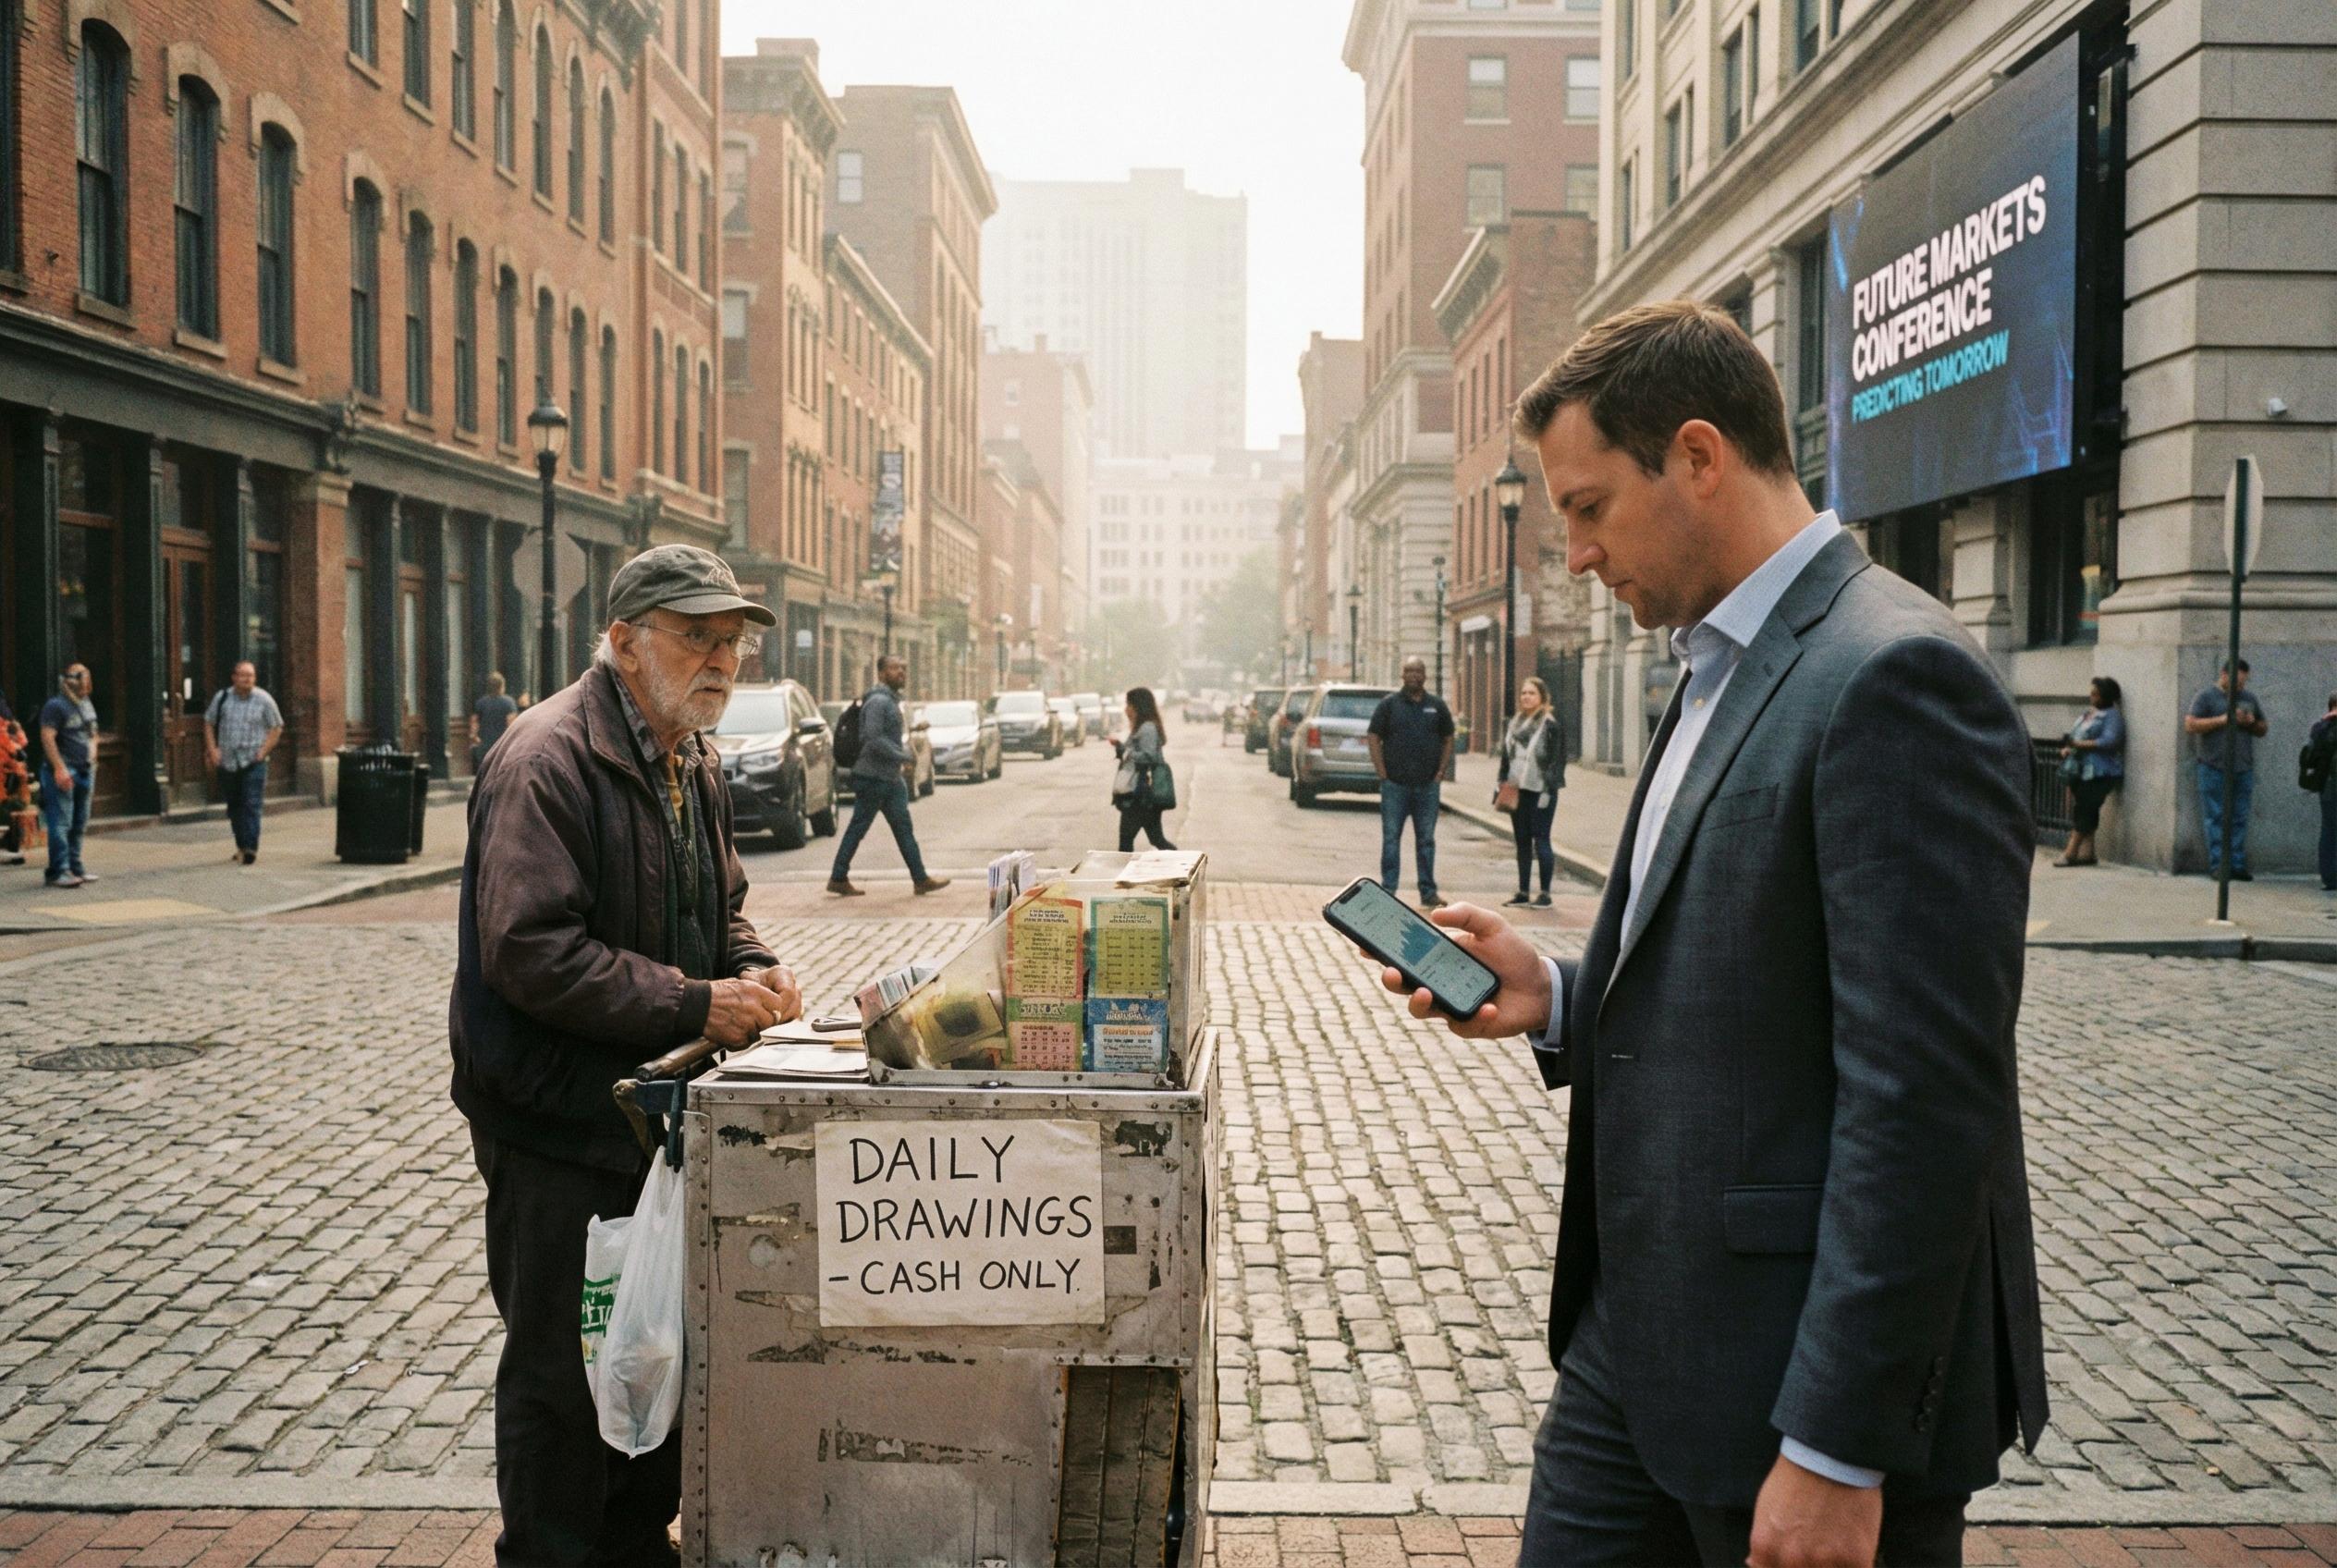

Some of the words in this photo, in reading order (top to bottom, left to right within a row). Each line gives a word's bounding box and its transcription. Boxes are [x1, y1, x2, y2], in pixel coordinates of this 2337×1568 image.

[1853, 242, 1928, 330] FUTURE
[1929, 174, 2047, 288] MARKETS
[1852, 266, 1993, 383] CONFERENCE
[1851, 367, 1926, 424] PREDICTING
[1925, 329, 2010, 392] TOMORROW
[849, 1134, 1015, 1184] DAILY
[836, 1195, 1093, 1243] DRAWINGS
[860, 1260, 960, 1295] CASH
